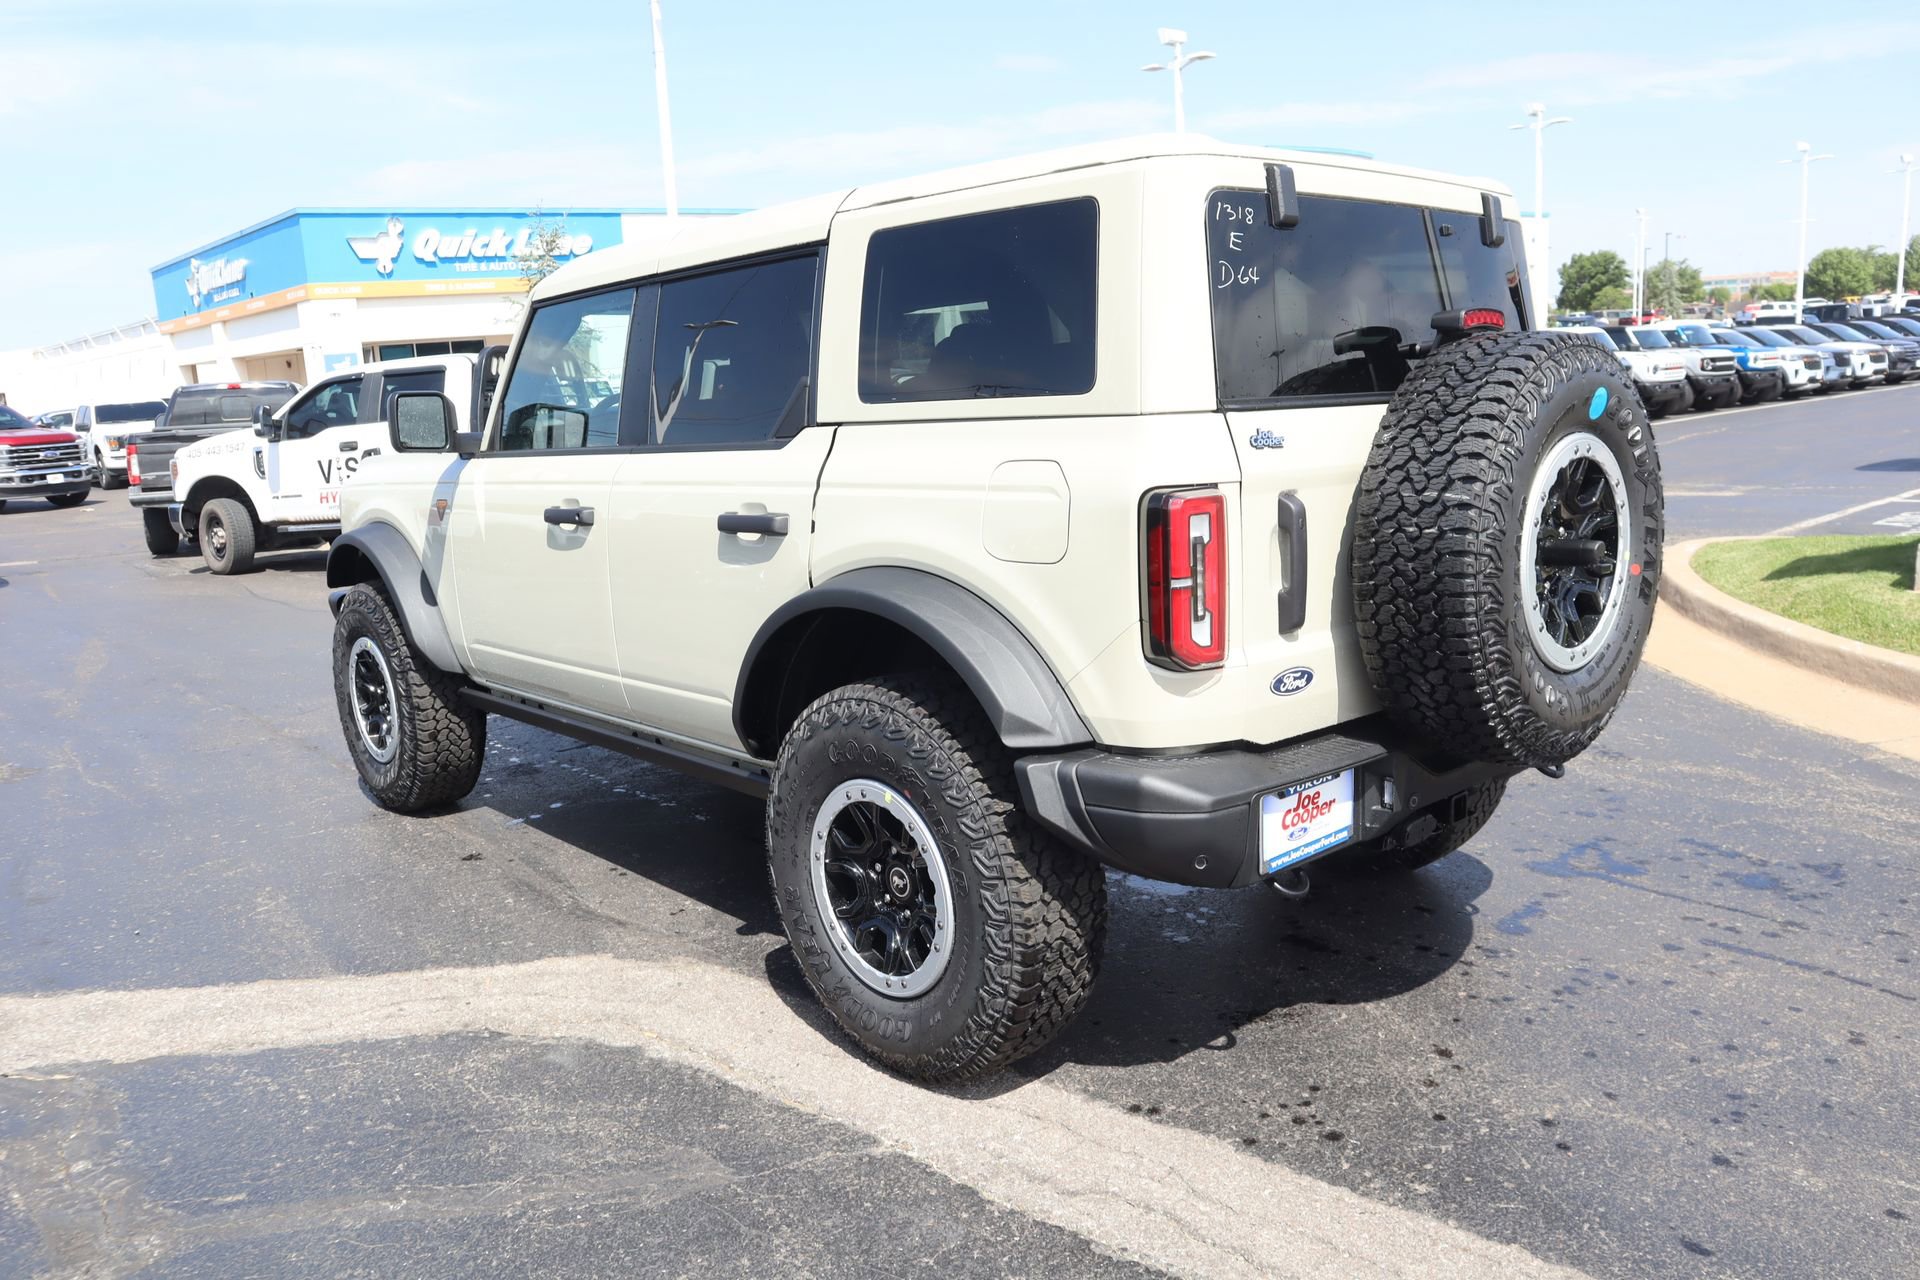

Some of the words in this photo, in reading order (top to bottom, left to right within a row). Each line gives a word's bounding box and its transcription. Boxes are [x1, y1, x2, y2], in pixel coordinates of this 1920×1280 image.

[1216, 201, 1254, 225] 1318
[413, 228, 512, 262] Quick
[1229, 231, 1244, 252] E
[455, 262, 478, 272] TIRE
[480, 262, 487, 271] &
[489, 261, 516, 271] AUTO
[1218, 260, 1260, 289] D64
[1249, 435, 1286, 448] Cooper
[1256, 427, 1274, 439] Joe
[1293, 790, 1321, 813] Joe
[1281, 797, 1336, 831] Cooper
